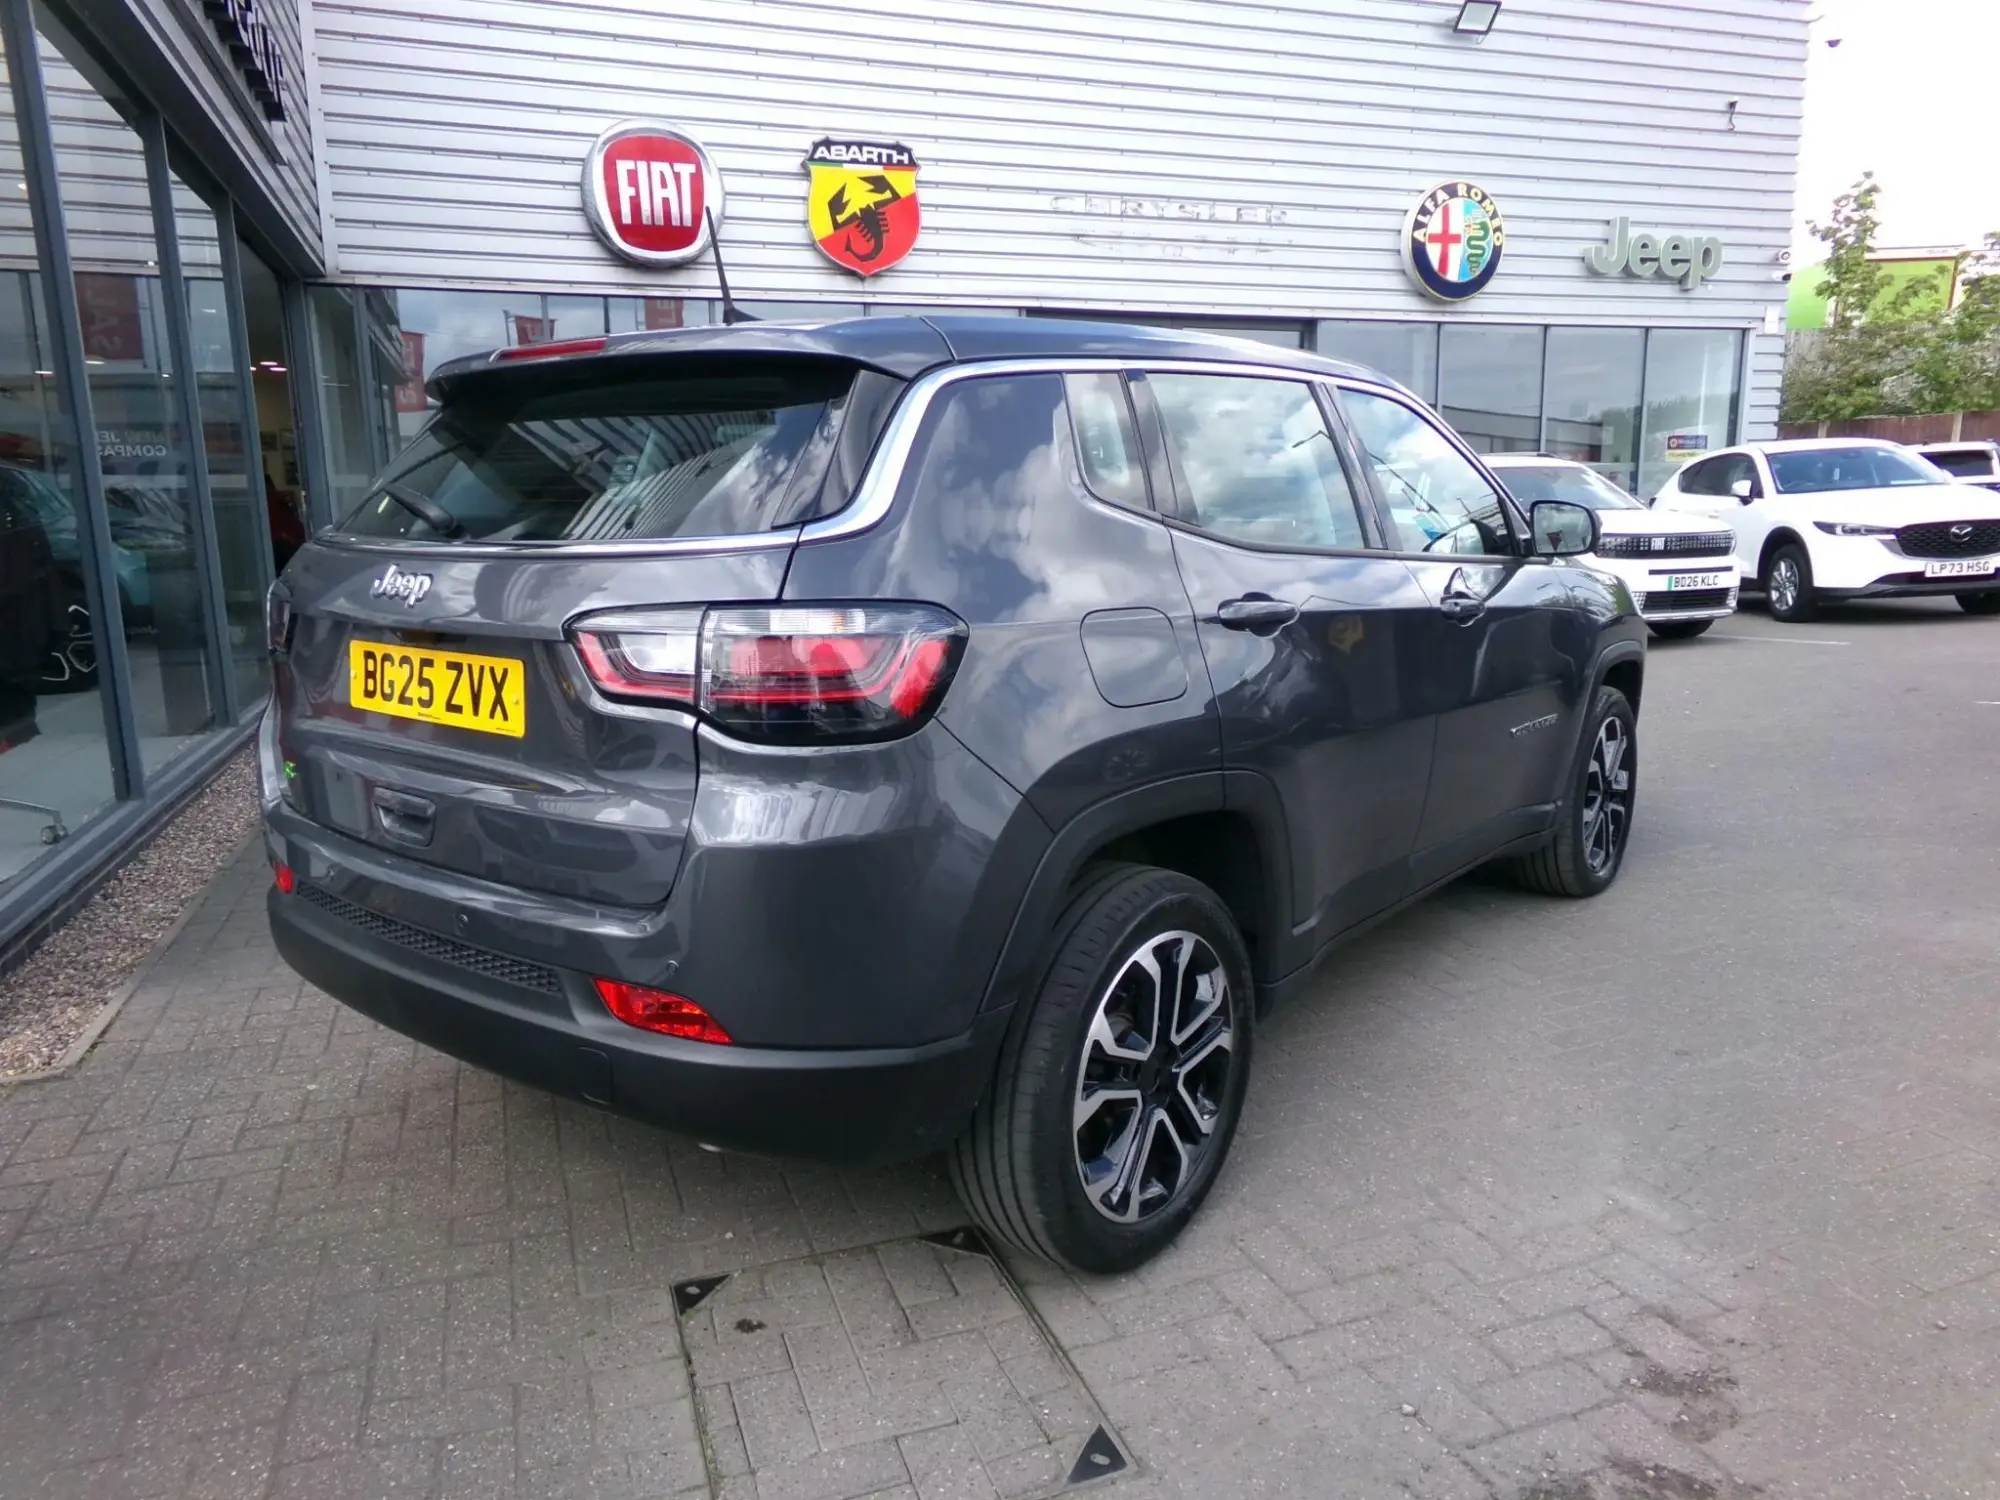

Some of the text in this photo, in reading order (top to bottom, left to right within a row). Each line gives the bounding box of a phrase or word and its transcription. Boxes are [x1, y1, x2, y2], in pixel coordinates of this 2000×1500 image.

[813, 144, 911, 165] ABARTH
[615, 159, 696, 228] FIAT
[1413, 183, 1503, 246] ALFA ROMEO
[1583, 216, 1724, 291] Jeep
[371, 563, 433, 608] Jeep
[1674, 575, 1719, 588] BD26 KLC
[1931, 561, 1990, 574] LP73 HSG
[363, 650, 509, 722] BG25 ZVX
